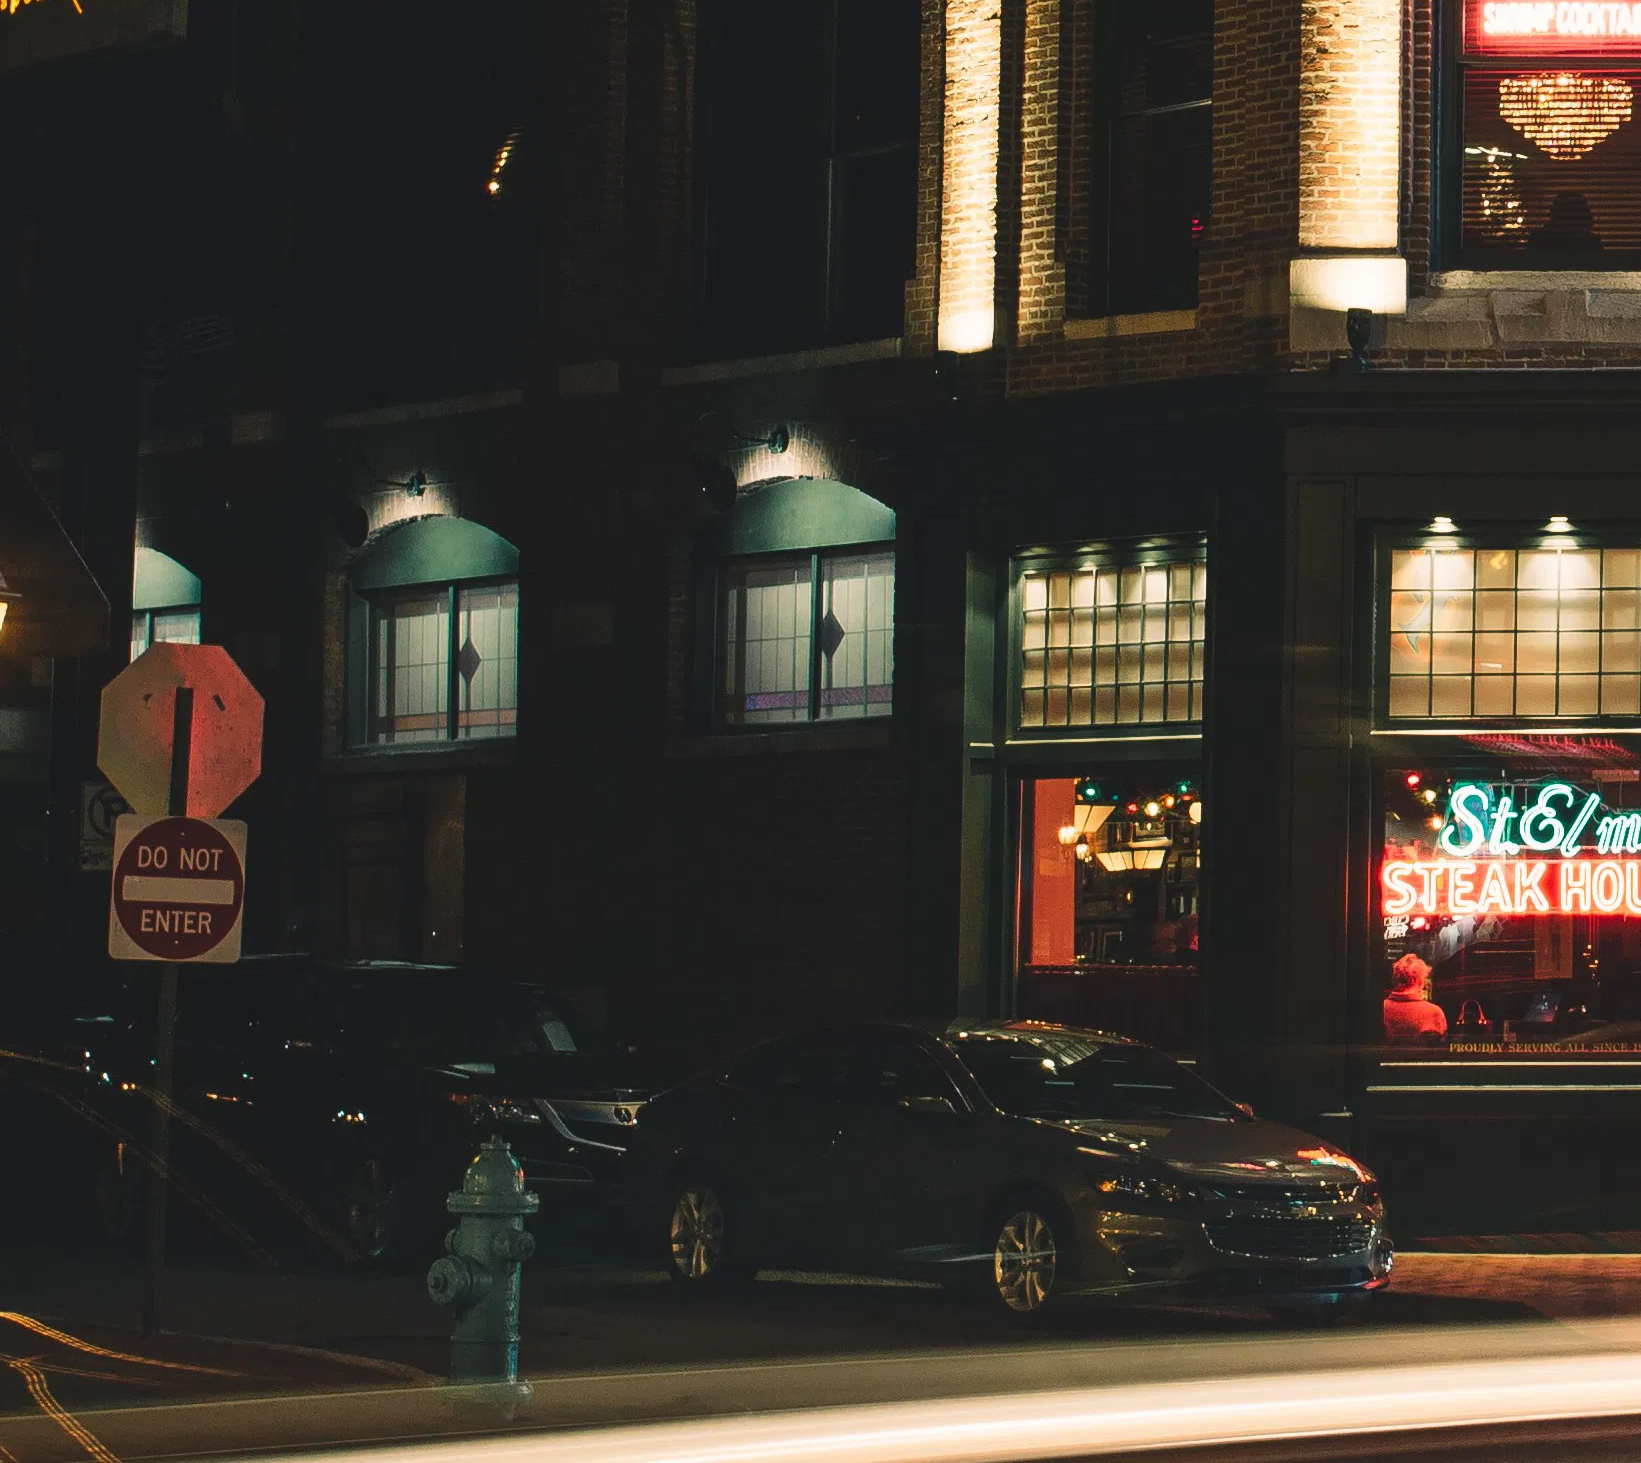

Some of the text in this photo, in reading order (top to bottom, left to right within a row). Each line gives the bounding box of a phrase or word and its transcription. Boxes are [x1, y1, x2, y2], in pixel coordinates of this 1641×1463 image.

[137, 845, 168, 869] DO
[179, 847, 224, 872] NOT
[1382, 861, 1550, 915] STEAK
[140, 909, 213, 935] ENTER
[1449, 1042, 1504, 1053] PROUDLY
[1508, 1042, 1561, 1053] SERVING
[1565, 1042, 1588, 1053] ALL
[1592, 1042, 1628, 1053] SINCE
